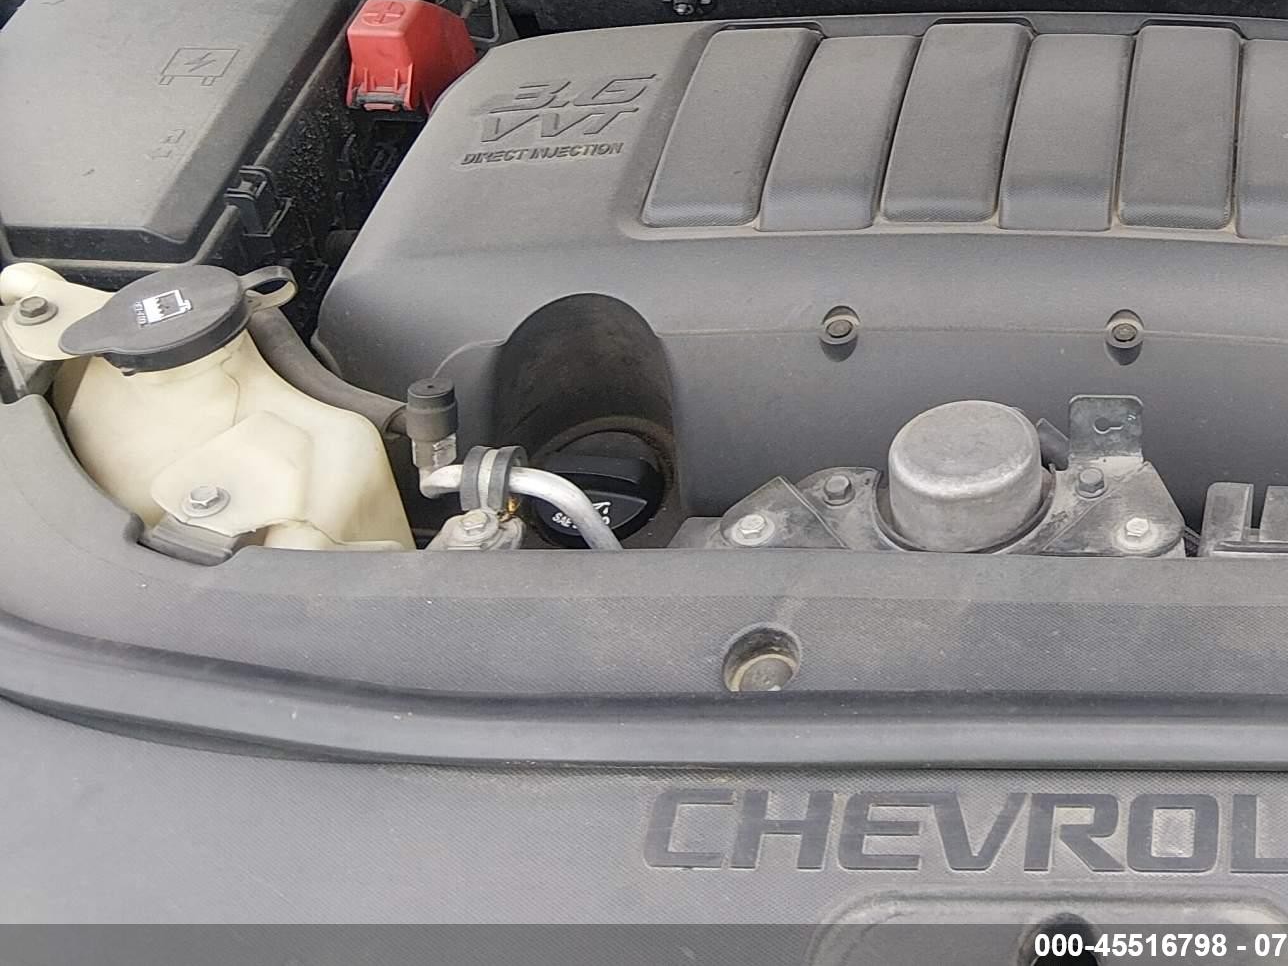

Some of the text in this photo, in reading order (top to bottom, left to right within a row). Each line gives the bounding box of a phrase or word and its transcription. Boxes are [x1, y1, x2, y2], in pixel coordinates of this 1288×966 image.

[480, 73, 657, 115] 3.6
[480, 107, 640, 143] VVT
[460, 142, 625, 165] DIRECT INJECTION
